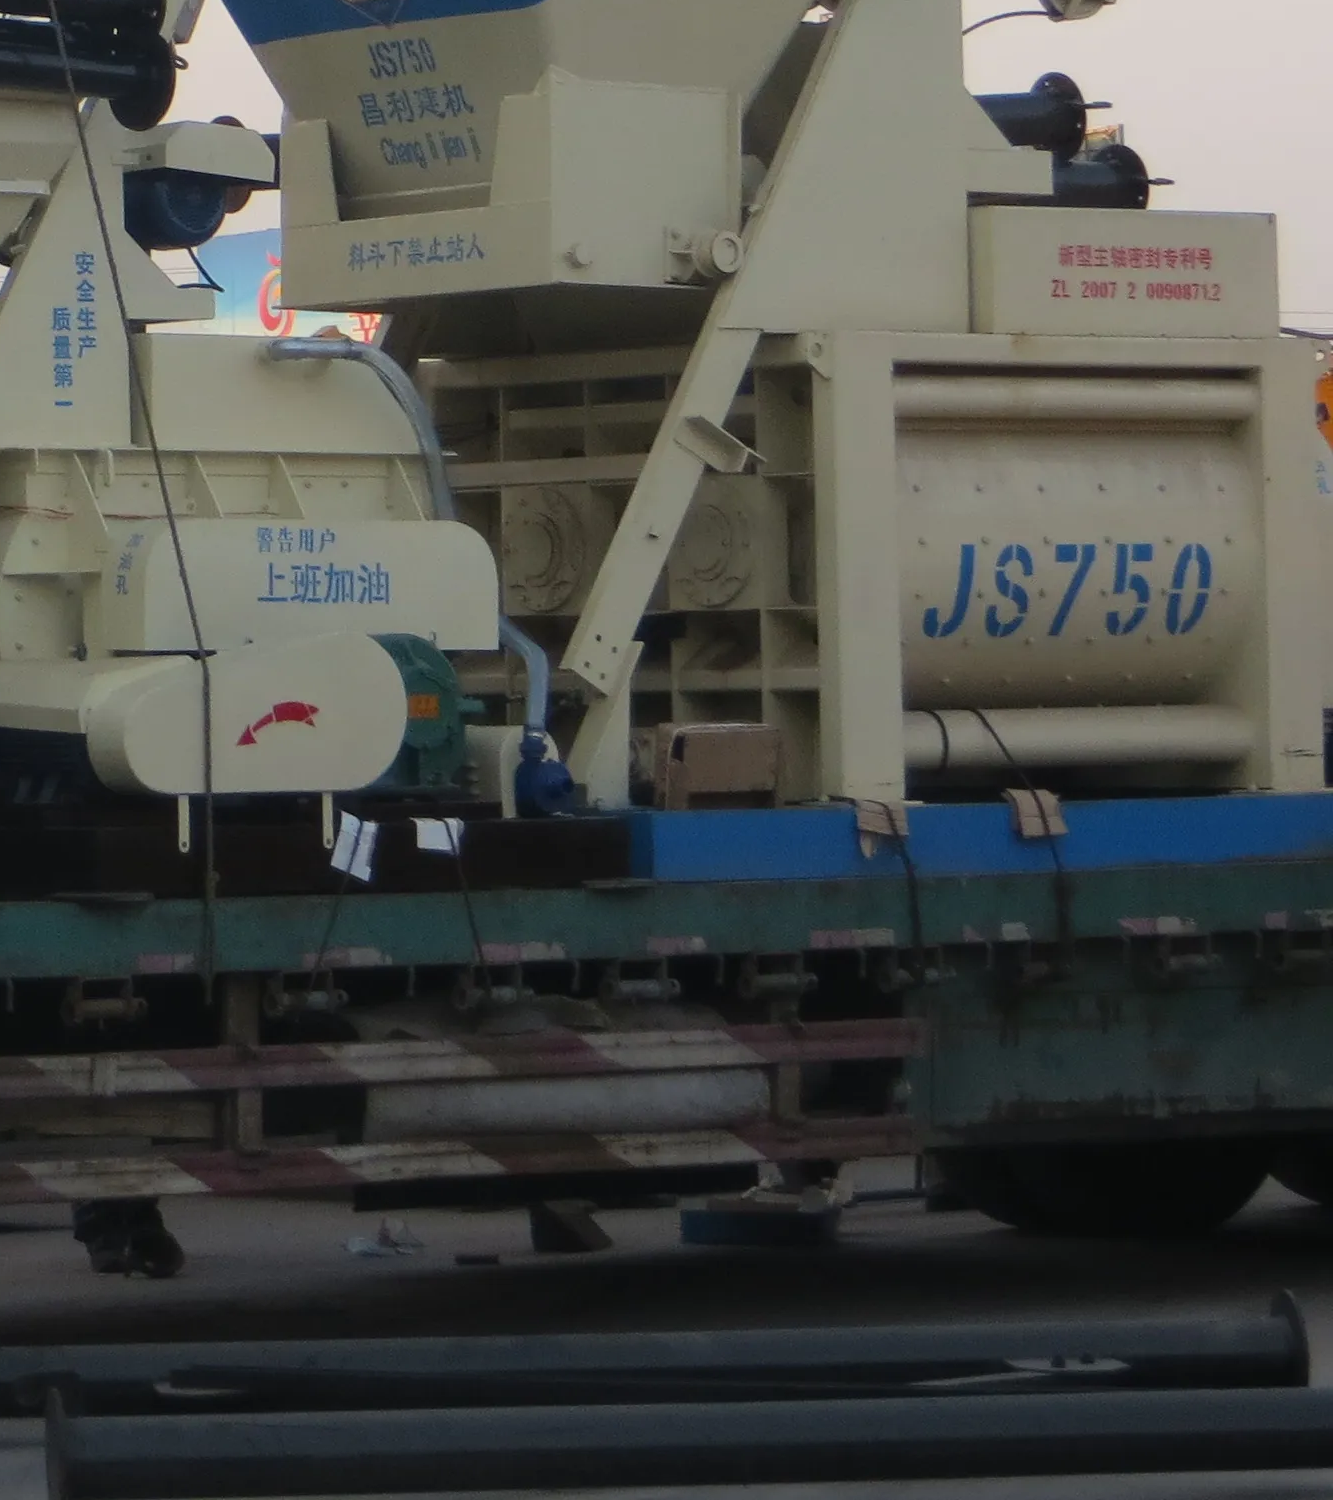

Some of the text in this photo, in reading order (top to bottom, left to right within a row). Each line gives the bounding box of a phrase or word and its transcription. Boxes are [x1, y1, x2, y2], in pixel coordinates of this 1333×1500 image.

[367, 37, 437, 80] JS750
[358, 83, 475, 128] 昌利建机
[1058, 244, 1213, 271] 新型主轴密封专利号
[75, 251, 97, 359] 安全生产
[1050, 279, 1072, 299] ZL
[1081, 281, 1117, 299] 2007
[1126, 281, 1137, 300] 2
[51, 307, 74, 407] 质量第一
[256, 526, 336, 554] 警告用户
[256, 562, 391, 605] 上班加油
[921, 542, 1213, 639] JS750
